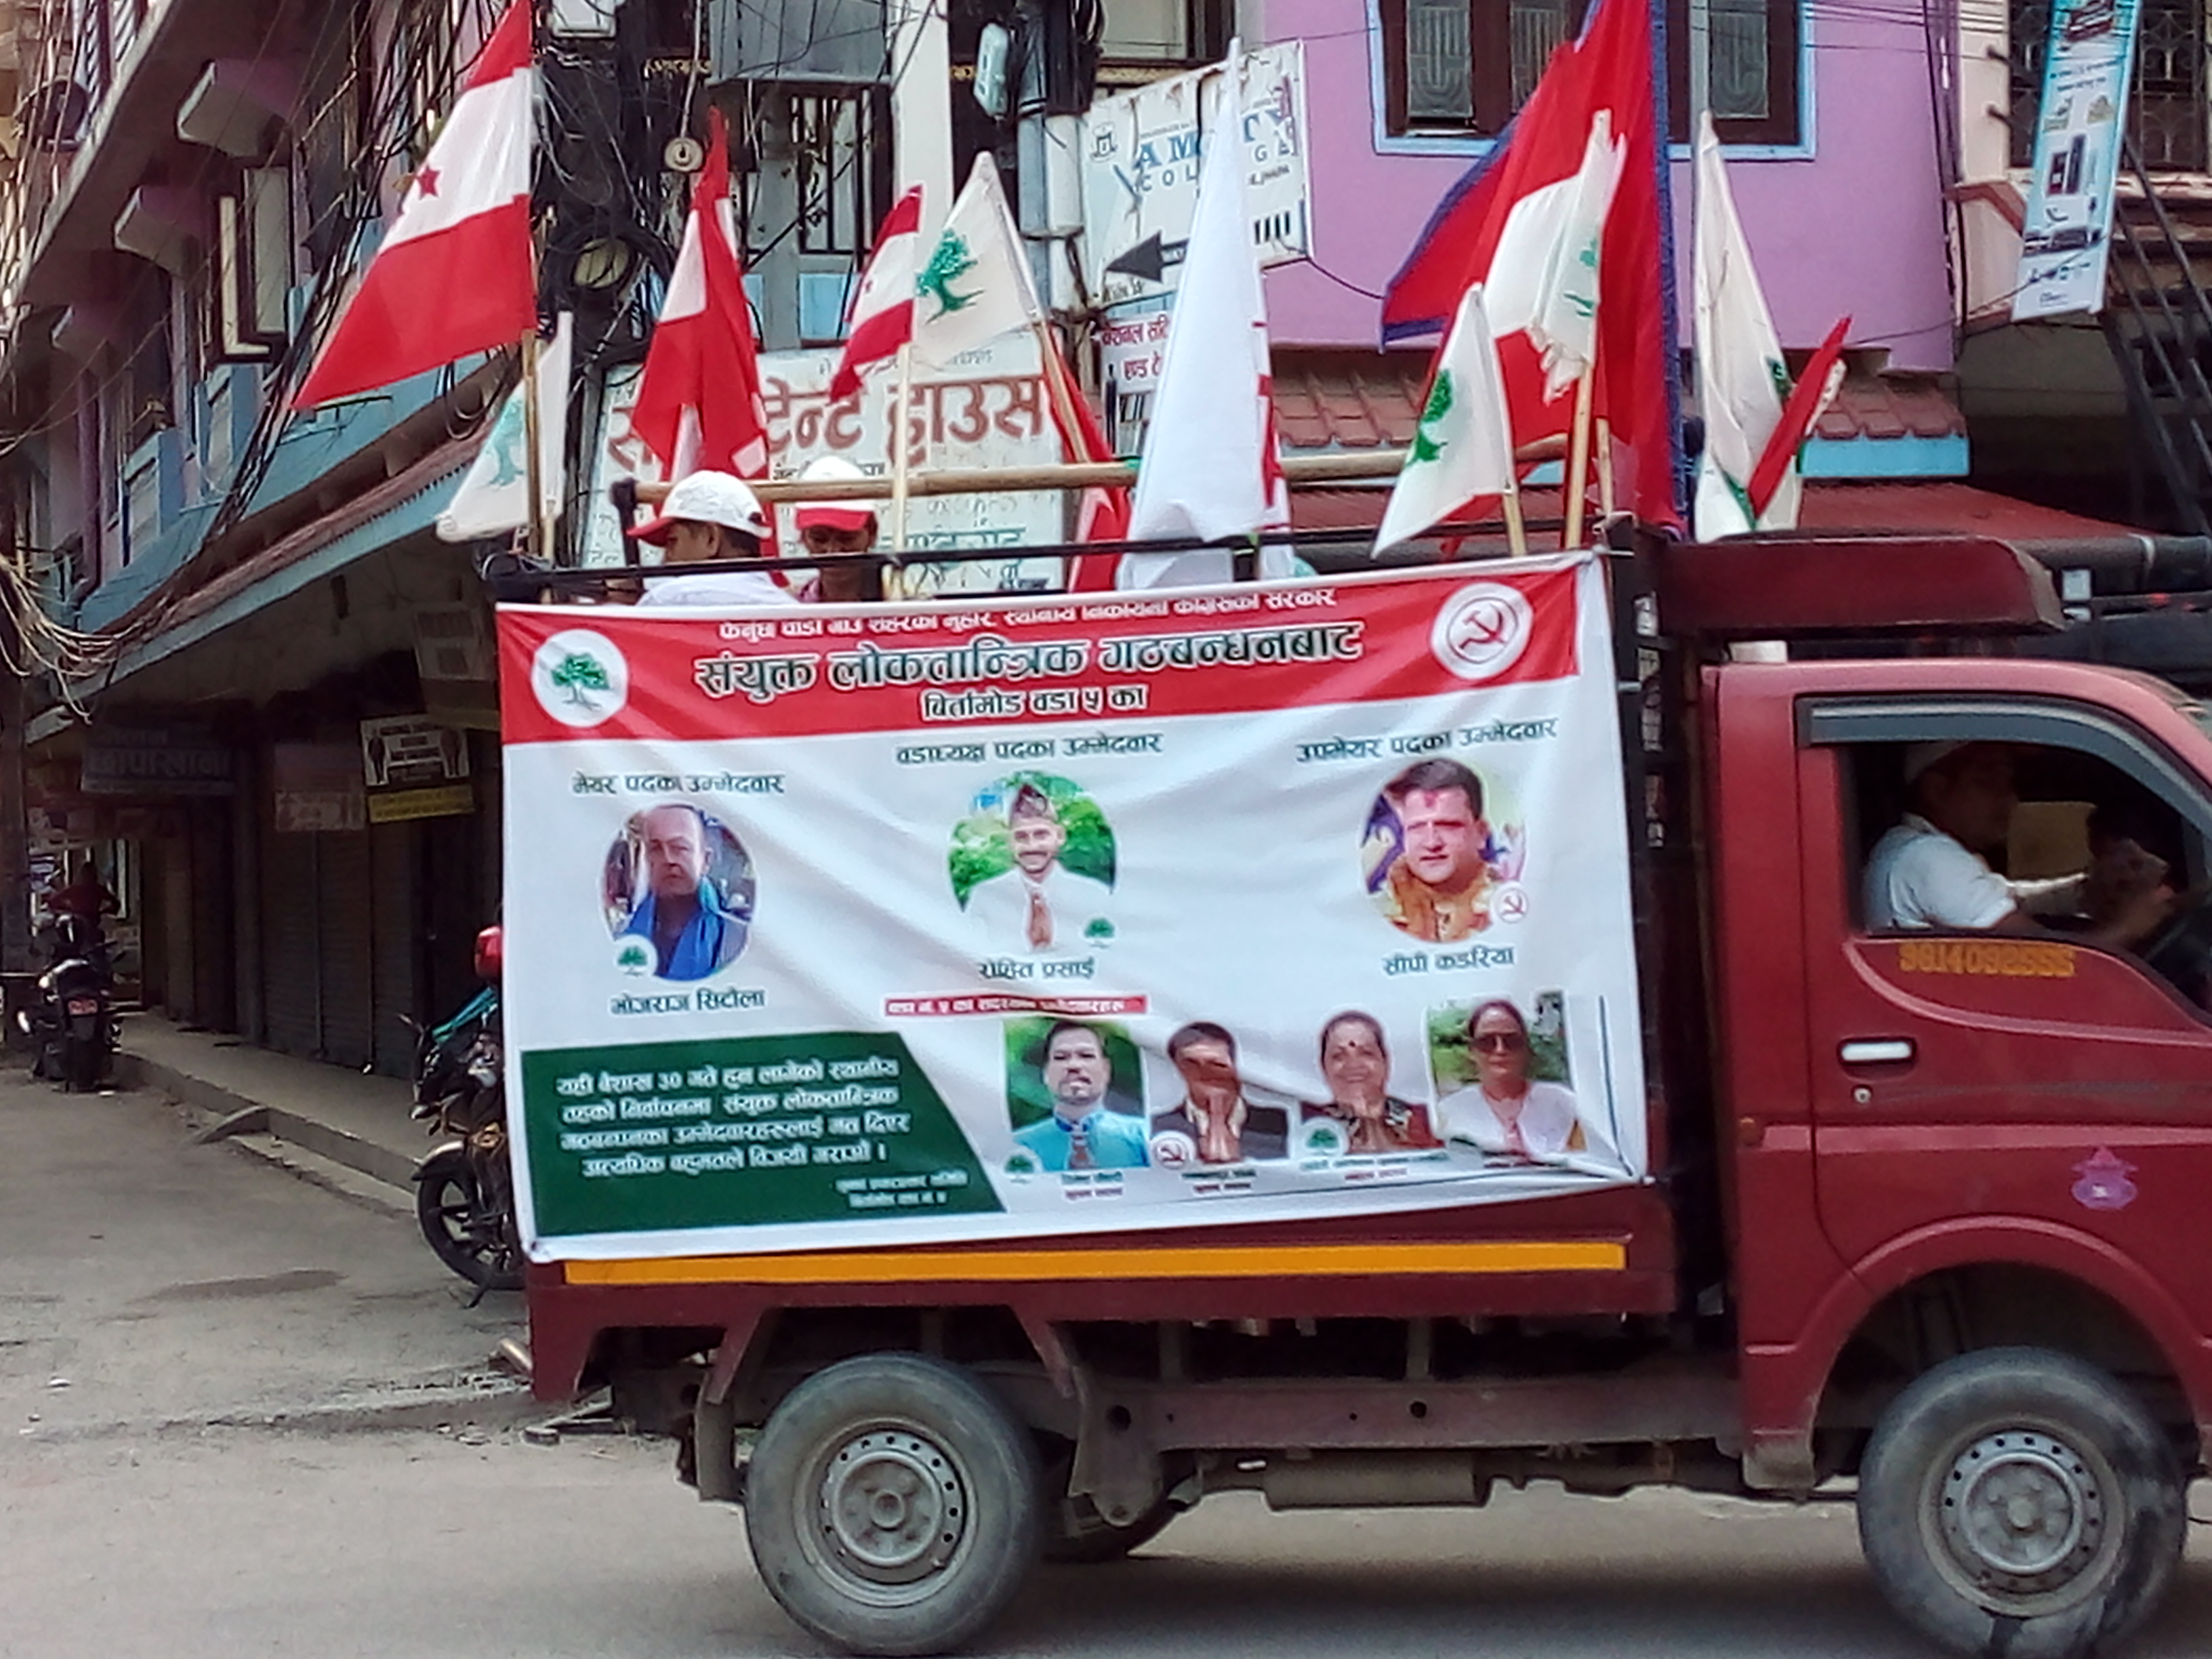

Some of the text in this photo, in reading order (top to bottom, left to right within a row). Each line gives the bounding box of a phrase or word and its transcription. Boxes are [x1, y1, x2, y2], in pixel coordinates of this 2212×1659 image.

[1133, 108, 1287, 168] AMTY
[1141, 139, 1290, 192] COLGE
[695, 649, 821, 702] संयुक्त
[1100, 621, 1364, 673] गठबन्धनबाट
[1029, 688, 1080, 715] वडा
[1082, 685, 1103, 714] ५
[1106, 684, 1149, 710] का
[993, 738, 1055, 760] पदका
[1061, 728, 1164, 756] उम्मेदवार
[1390, 731, 1452, 755] पदका
[1458, 717, 1559, 747] उम्मेदवार
[684, 771, 785, 794] उम्मेदवार
